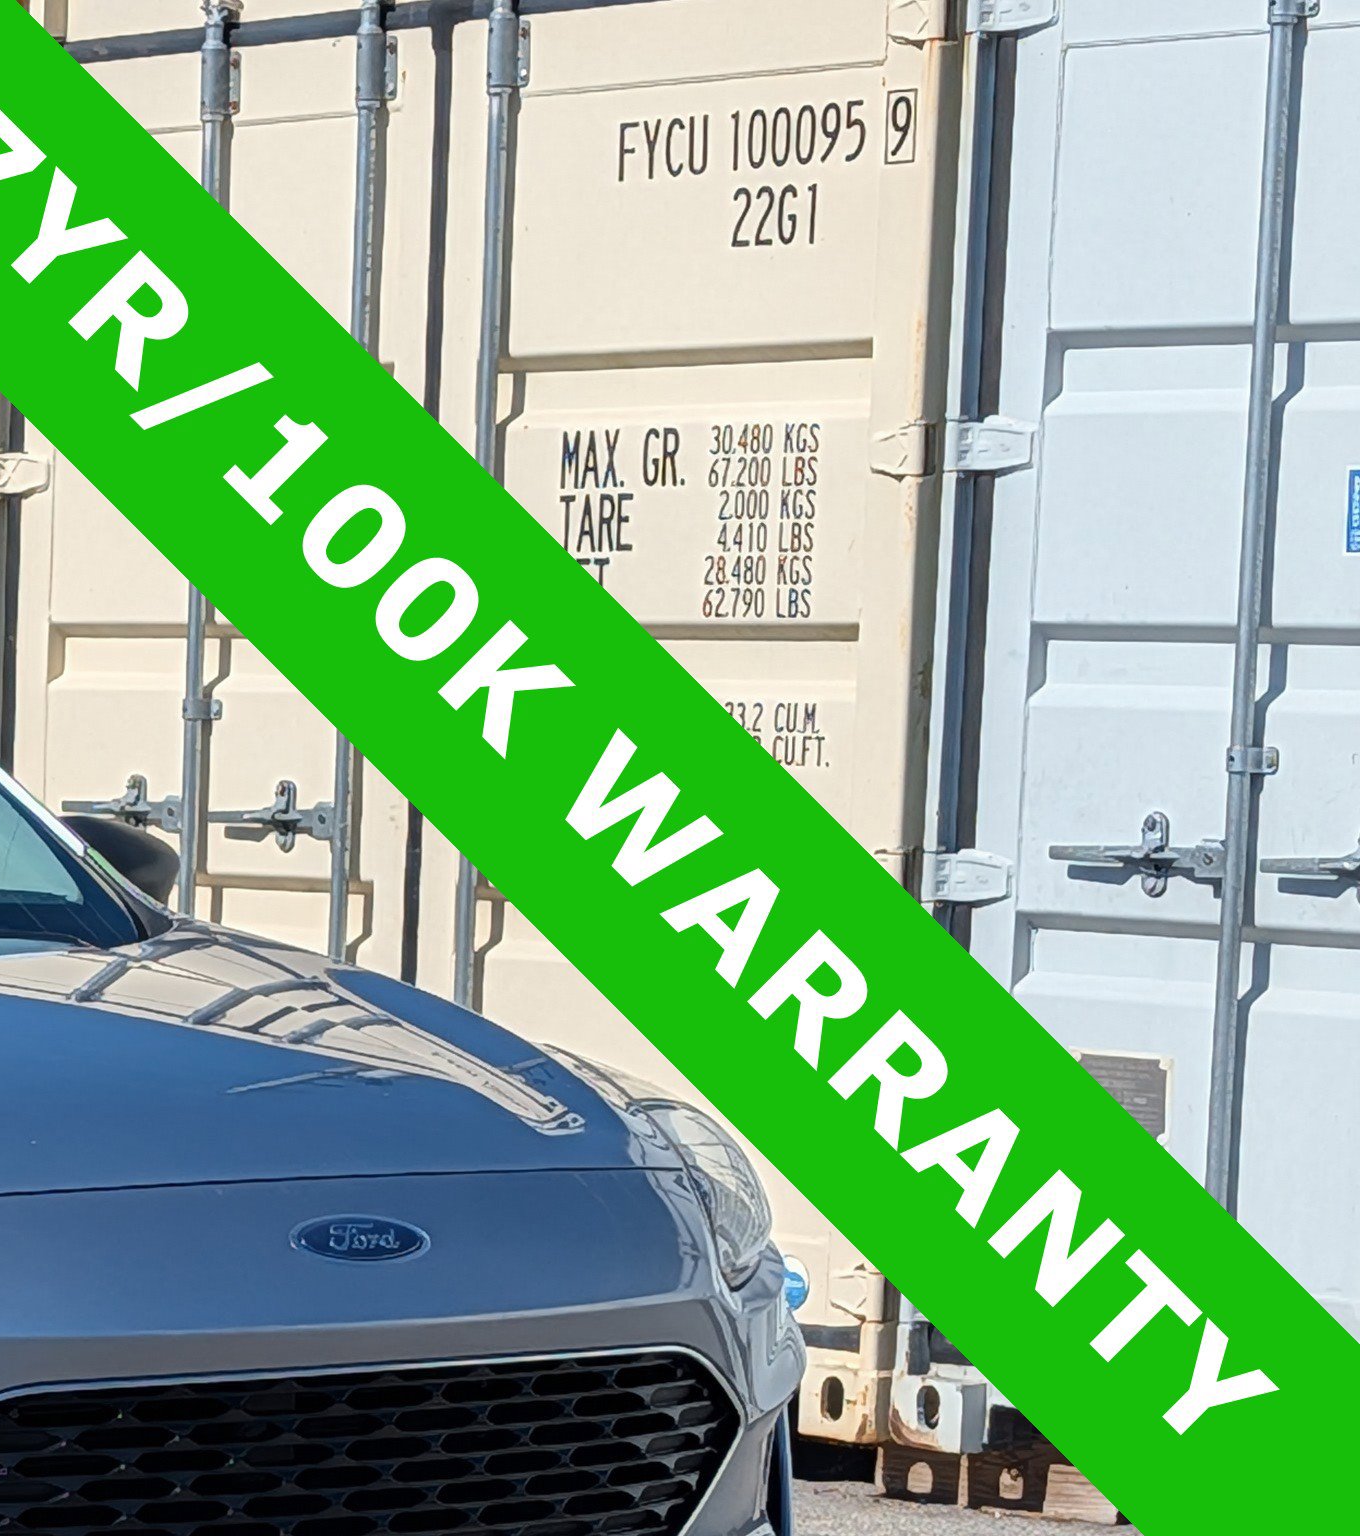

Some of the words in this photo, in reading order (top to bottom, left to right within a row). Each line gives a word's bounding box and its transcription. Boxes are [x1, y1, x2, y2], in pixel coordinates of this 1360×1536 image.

[618, 113, 710, 182] FYCU
[730, 99, 867, 172] 100095
[891, 95, 912, 157] 9
[730, 183, 819, 248] 22G1
[559, 428, 625, 490] MAX.
[642, 427, 685, 487] GR.
[783, 423, 821, 454] KGS
[781, 456, 819, 487] LBS
[559, 493, 635, 553] TARE
[779, 489, 817, 520] KGS
[778, 521, 815, 553] LBS
[776, 554, 813, 586] KGS
[775, 587, 812, 619] LBS
[329, 1222, 401, 1250] Ford
